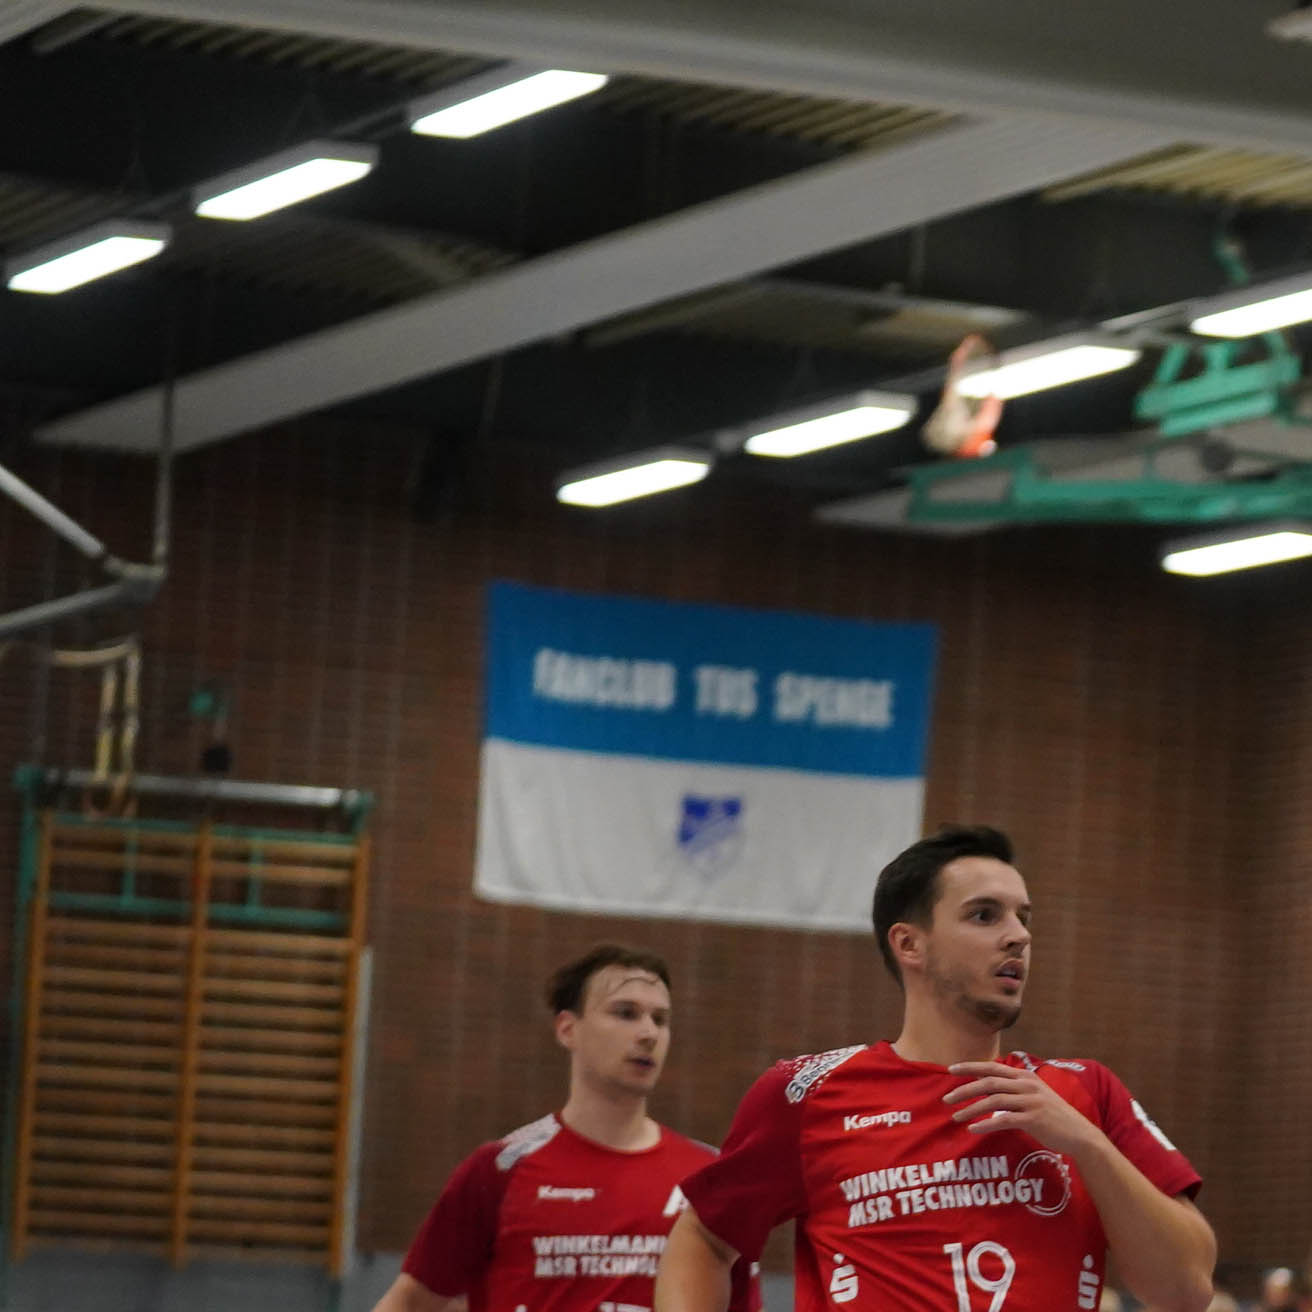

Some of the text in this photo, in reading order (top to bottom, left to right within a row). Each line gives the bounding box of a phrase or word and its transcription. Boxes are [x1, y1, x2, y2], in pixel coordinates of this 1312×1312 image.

[694, 664, 759, 719] TUS
[773, 671, 895, 730] SPENGE
[843, 1110, 912, 1131] Kempa
[839, 1155, 1009, 1201] WINKELMANN
[848, 1177, 1045, 1229] MSR TECHNOLOGY
